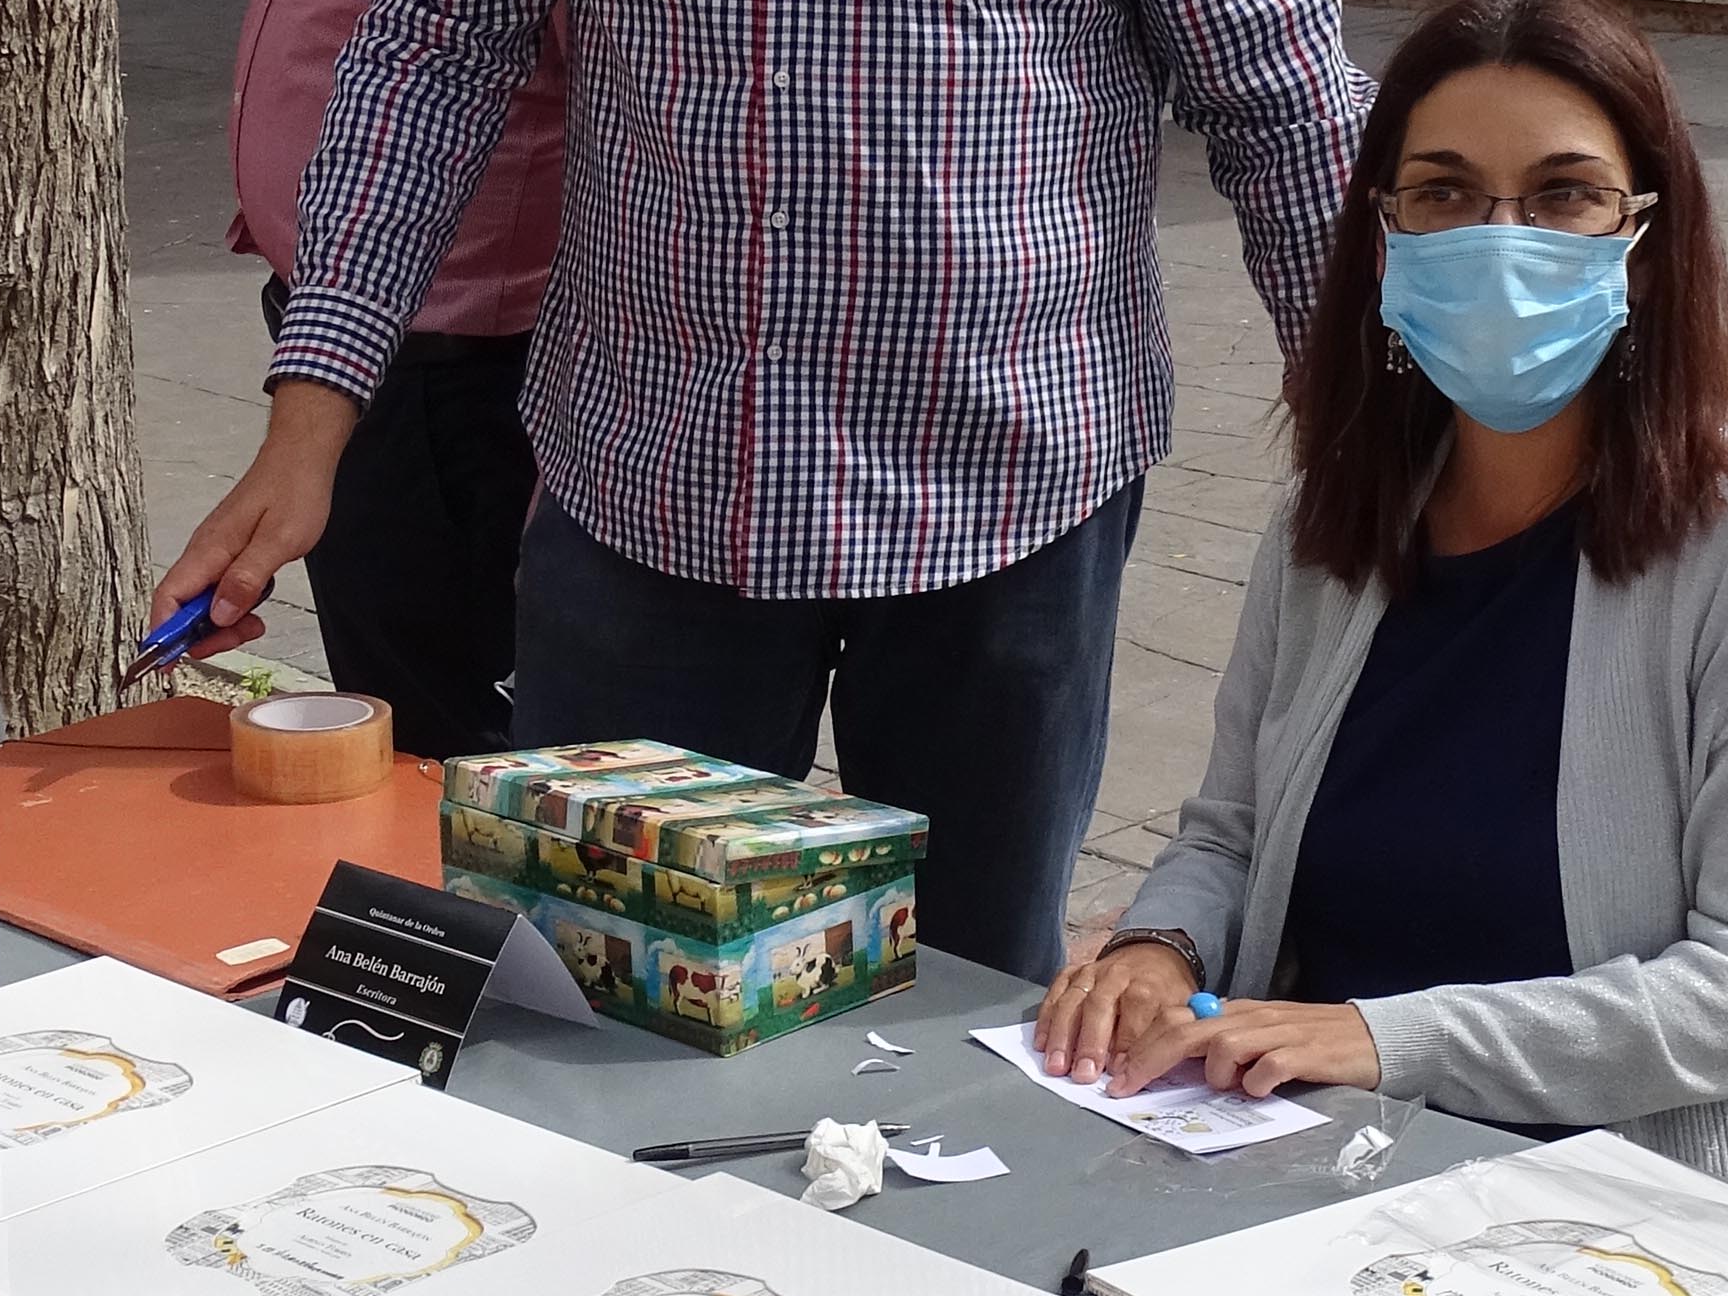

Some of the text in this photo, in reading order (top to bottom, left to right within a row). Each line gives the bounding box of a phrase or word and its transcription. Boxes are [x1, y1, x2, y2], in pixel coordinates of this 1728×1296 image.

[369, 907, 446, 938] Quintanar de la Orden
[325, 944, 447, 996] Ana Belén Barrajón
[356, 984, 397, 1006] Escritora
[33, 1089, 54, 1099] en
[54, 1096, 84, 1111] casa
[296, 1207, 422, 1261] Ratones en casa
[1488, 1260, 1559, 1296] Ratones
